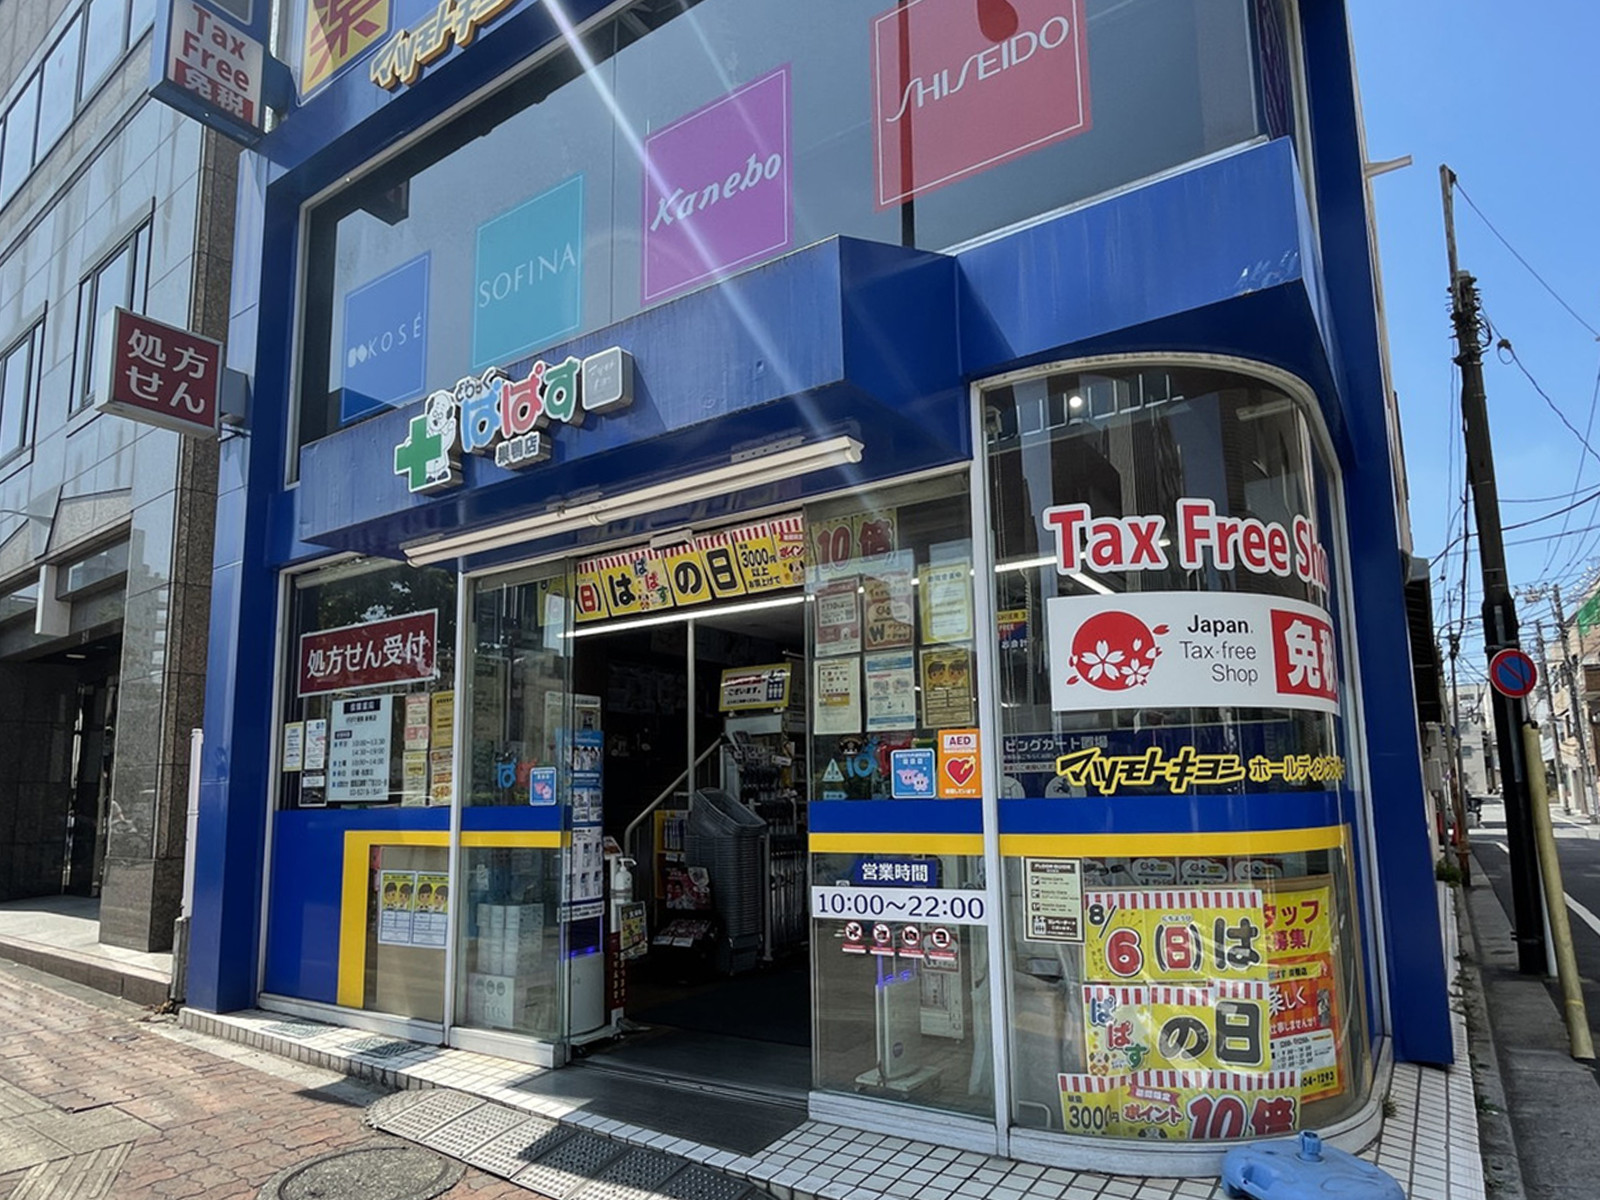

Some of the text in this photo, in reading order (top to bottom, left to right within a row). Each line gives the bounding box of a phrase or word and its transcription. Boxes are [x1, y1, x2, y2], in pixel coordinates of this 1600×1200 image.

[193, 3, 246, 61] Tax
[182, 29, 249, 92] Free
[885, 15, 1070, 123] SHISEIDO
[184, 66, 246, 118] 免税
[650, 150, 782, 232] Kanebo
[478, 242, 577, 308] SOFINA
[127, 327, 209, 379] 処方
[367, 312, 423, 361] KOSÉ
[125, 365, 206, 414] せん
[460, 357, 580, 452] ぱぱす
[1043, 504, 1168, 575] Tax
[1177, 498, 1290, 577] Free
[674, 548, 738, 595] の日
[306, 630, 427, 679] 処方せん受付
[1211, 663, 1259, 686] Shop
[949, 735, 972, 746] AED
[1056, 747, 1246, 794] マツモトキヨシ
[862, 862, 929, 883] 営業時間
[818, 892, 985, 920] 10:00～22:00
[1089, 996, 1149, 1068] ぱぱす
[1157, 1000, 1263, 1066] の日
[1124, 1103, 1184, 1124] ポイント
